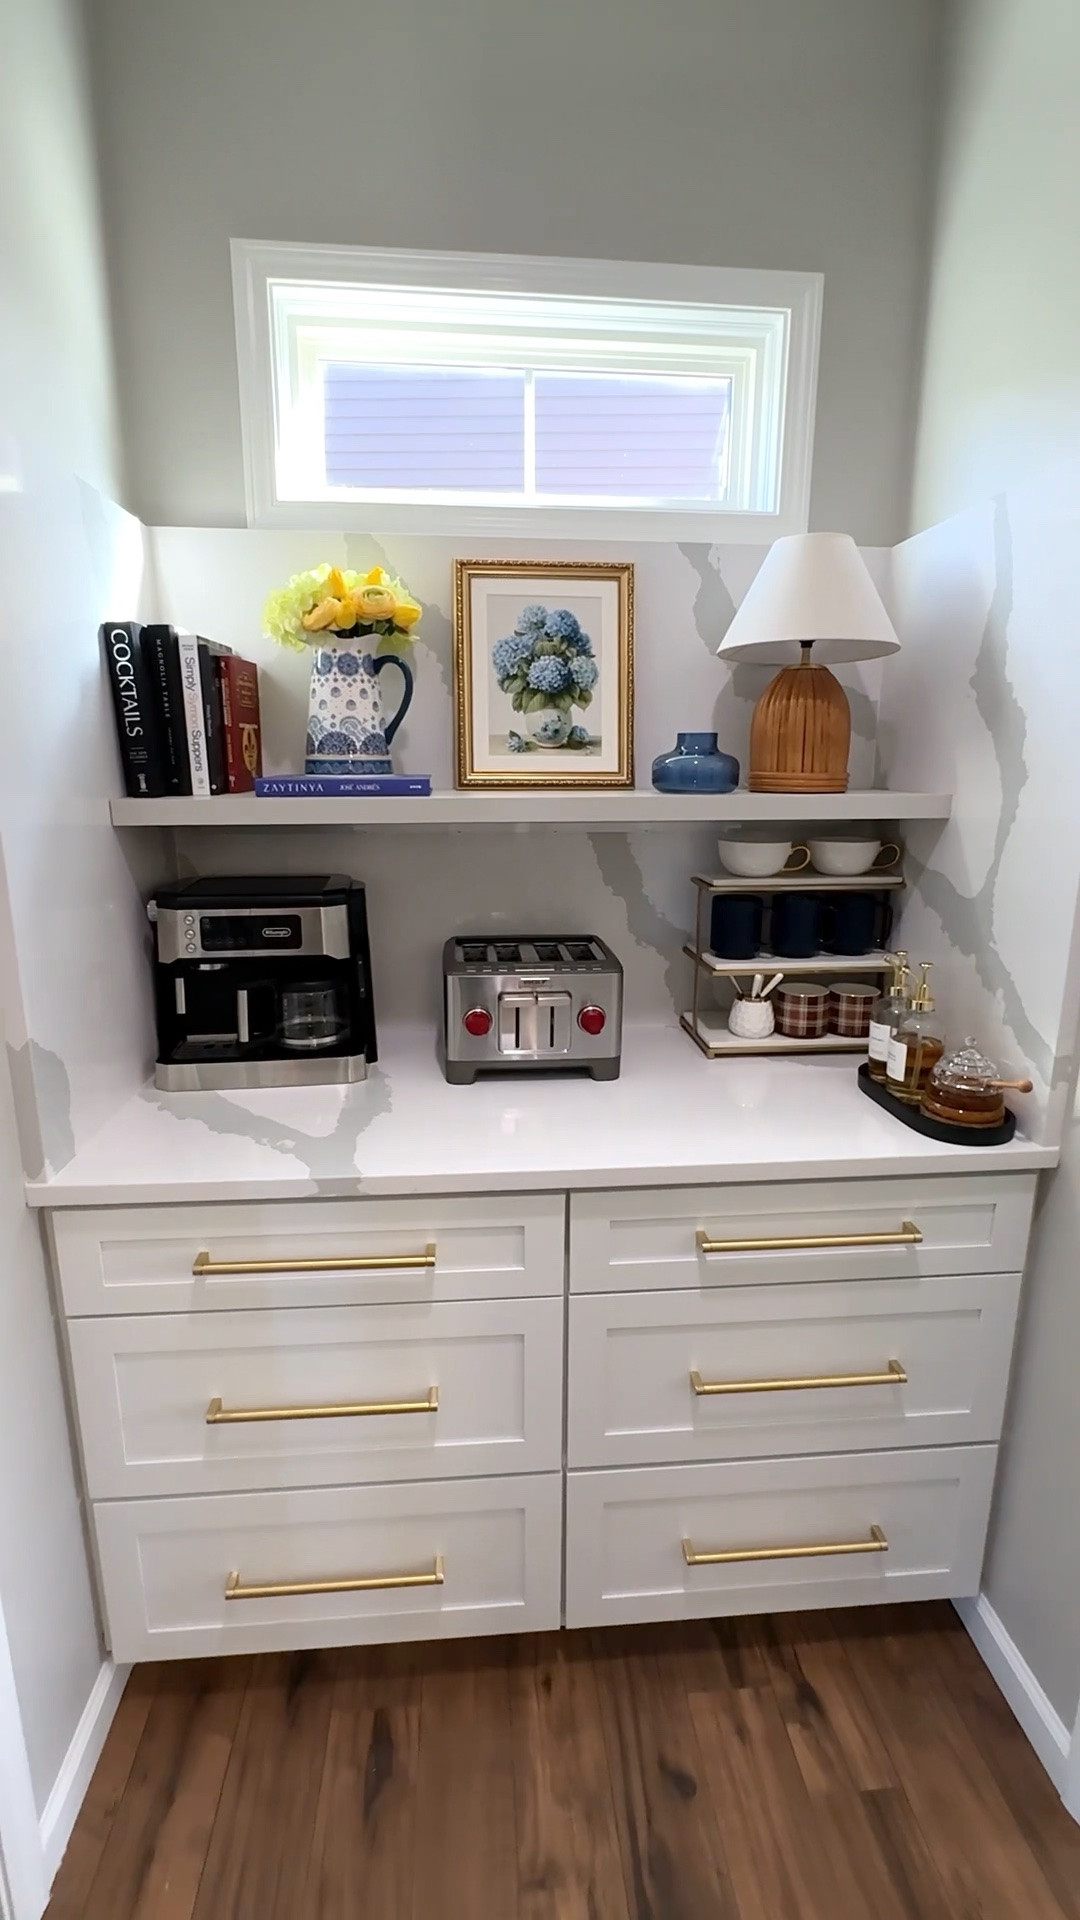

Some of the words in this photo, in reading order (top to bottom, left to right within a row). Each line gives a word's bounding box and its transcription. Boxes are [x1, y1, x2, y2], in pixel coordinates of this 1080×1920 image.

[111, 629, 143, 737] COCKTAILS
[156, 639, 167, 686] MAGNOLIA
[163, 690, 171, 718] TABLE
[184, 656, 196, 692] Simply
[191, 729, 203, 772] Suppers
[263, 783, 324, 793] ZAYTINYA
